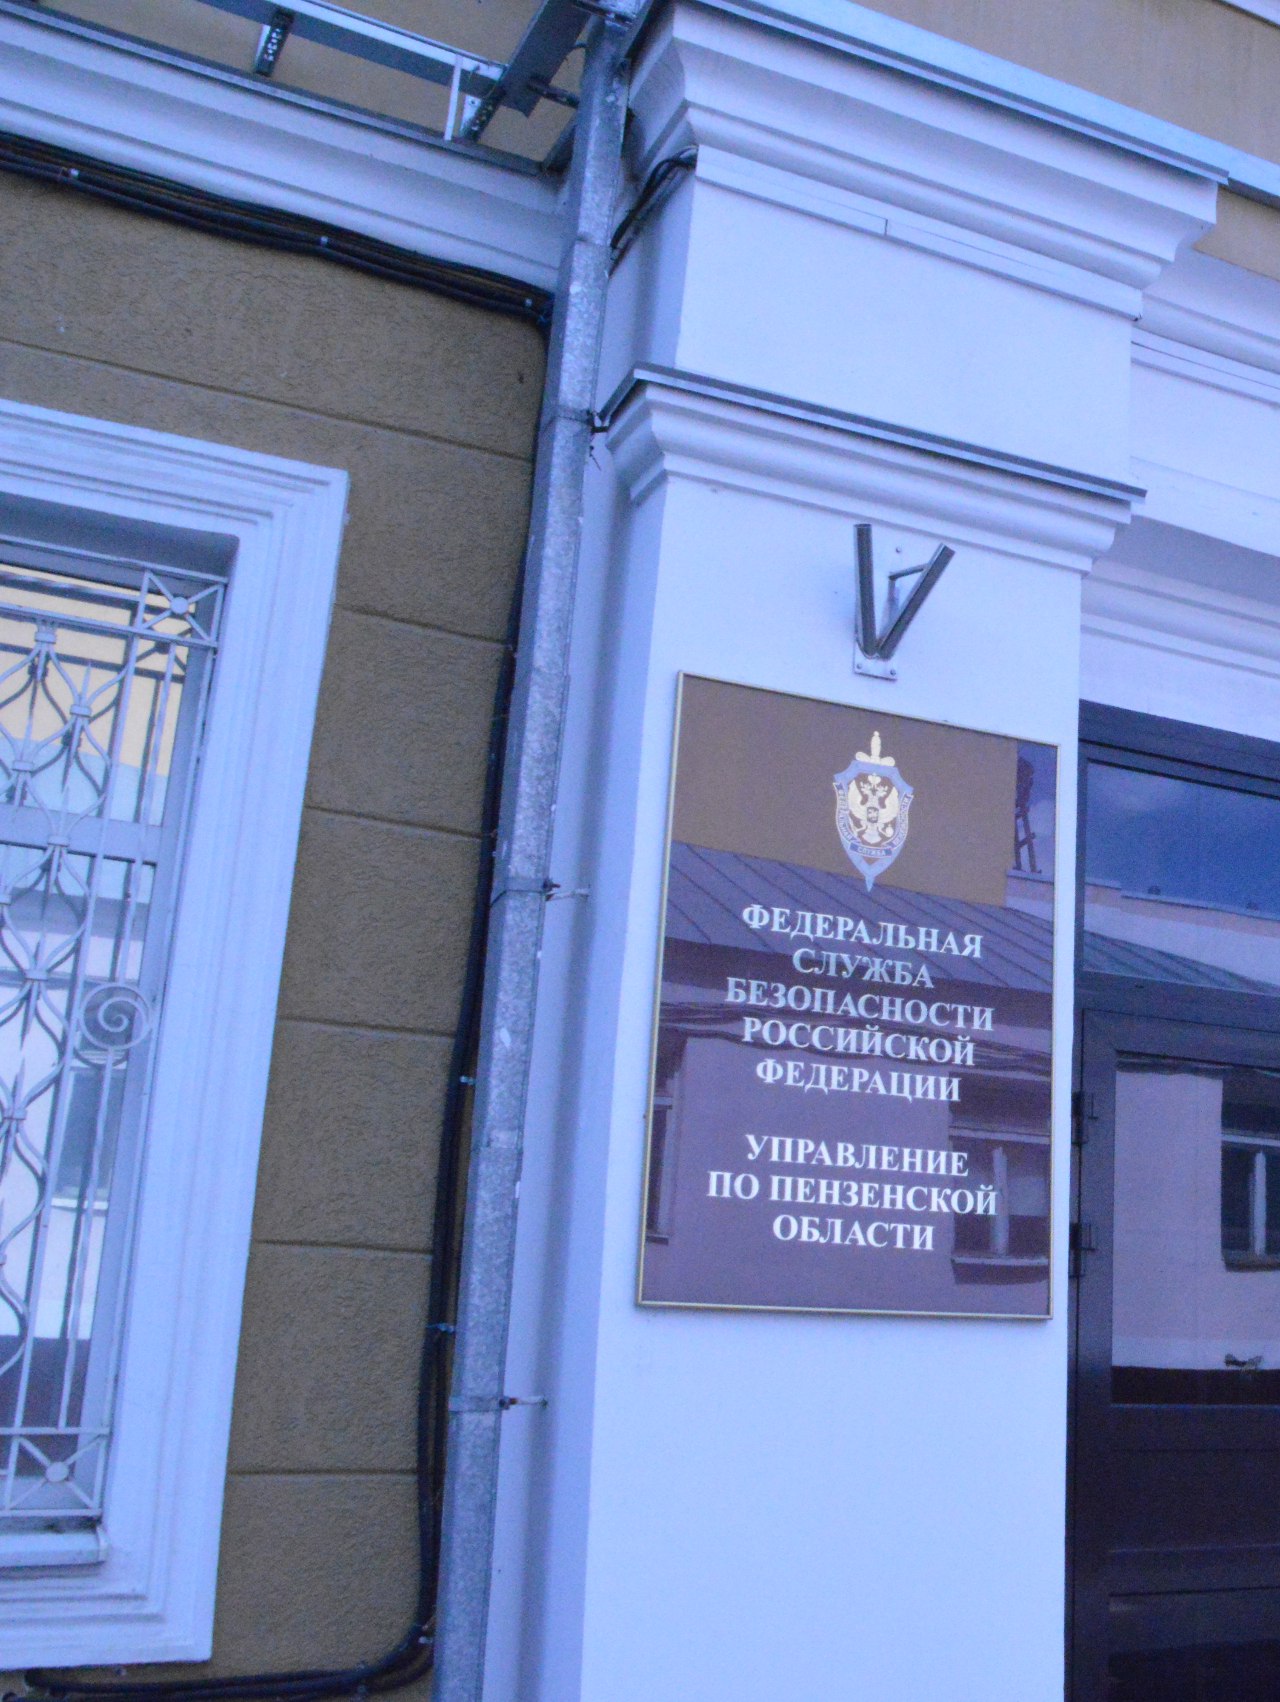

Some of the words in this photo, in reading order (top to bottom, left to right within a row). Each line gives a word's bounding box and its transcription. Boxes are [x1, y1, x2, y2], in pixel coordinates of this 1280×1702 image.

[742, 904, 983, 958] ФЕДЕРАЛЬНАЯ
[793, 947, 934, 988] СЛУЖБА
[725, 978, 994, 1031] БЕЗОПАСНОСТИ
[742, 1017, 975, 1066] РОССИЙСКОЙ
[756, 1059, 961, 1103] ФЕДЕРАЦИИ
[745, 1134, 969, 1176] УПРАВЛЕНИЕ
[707, 1171, 759, 1200] ПО
[770, 1176, 998, 1215] ПЕНЗЕНСКОЙ
[773, 1214, 934, 1251] ОБЛАСТИ
